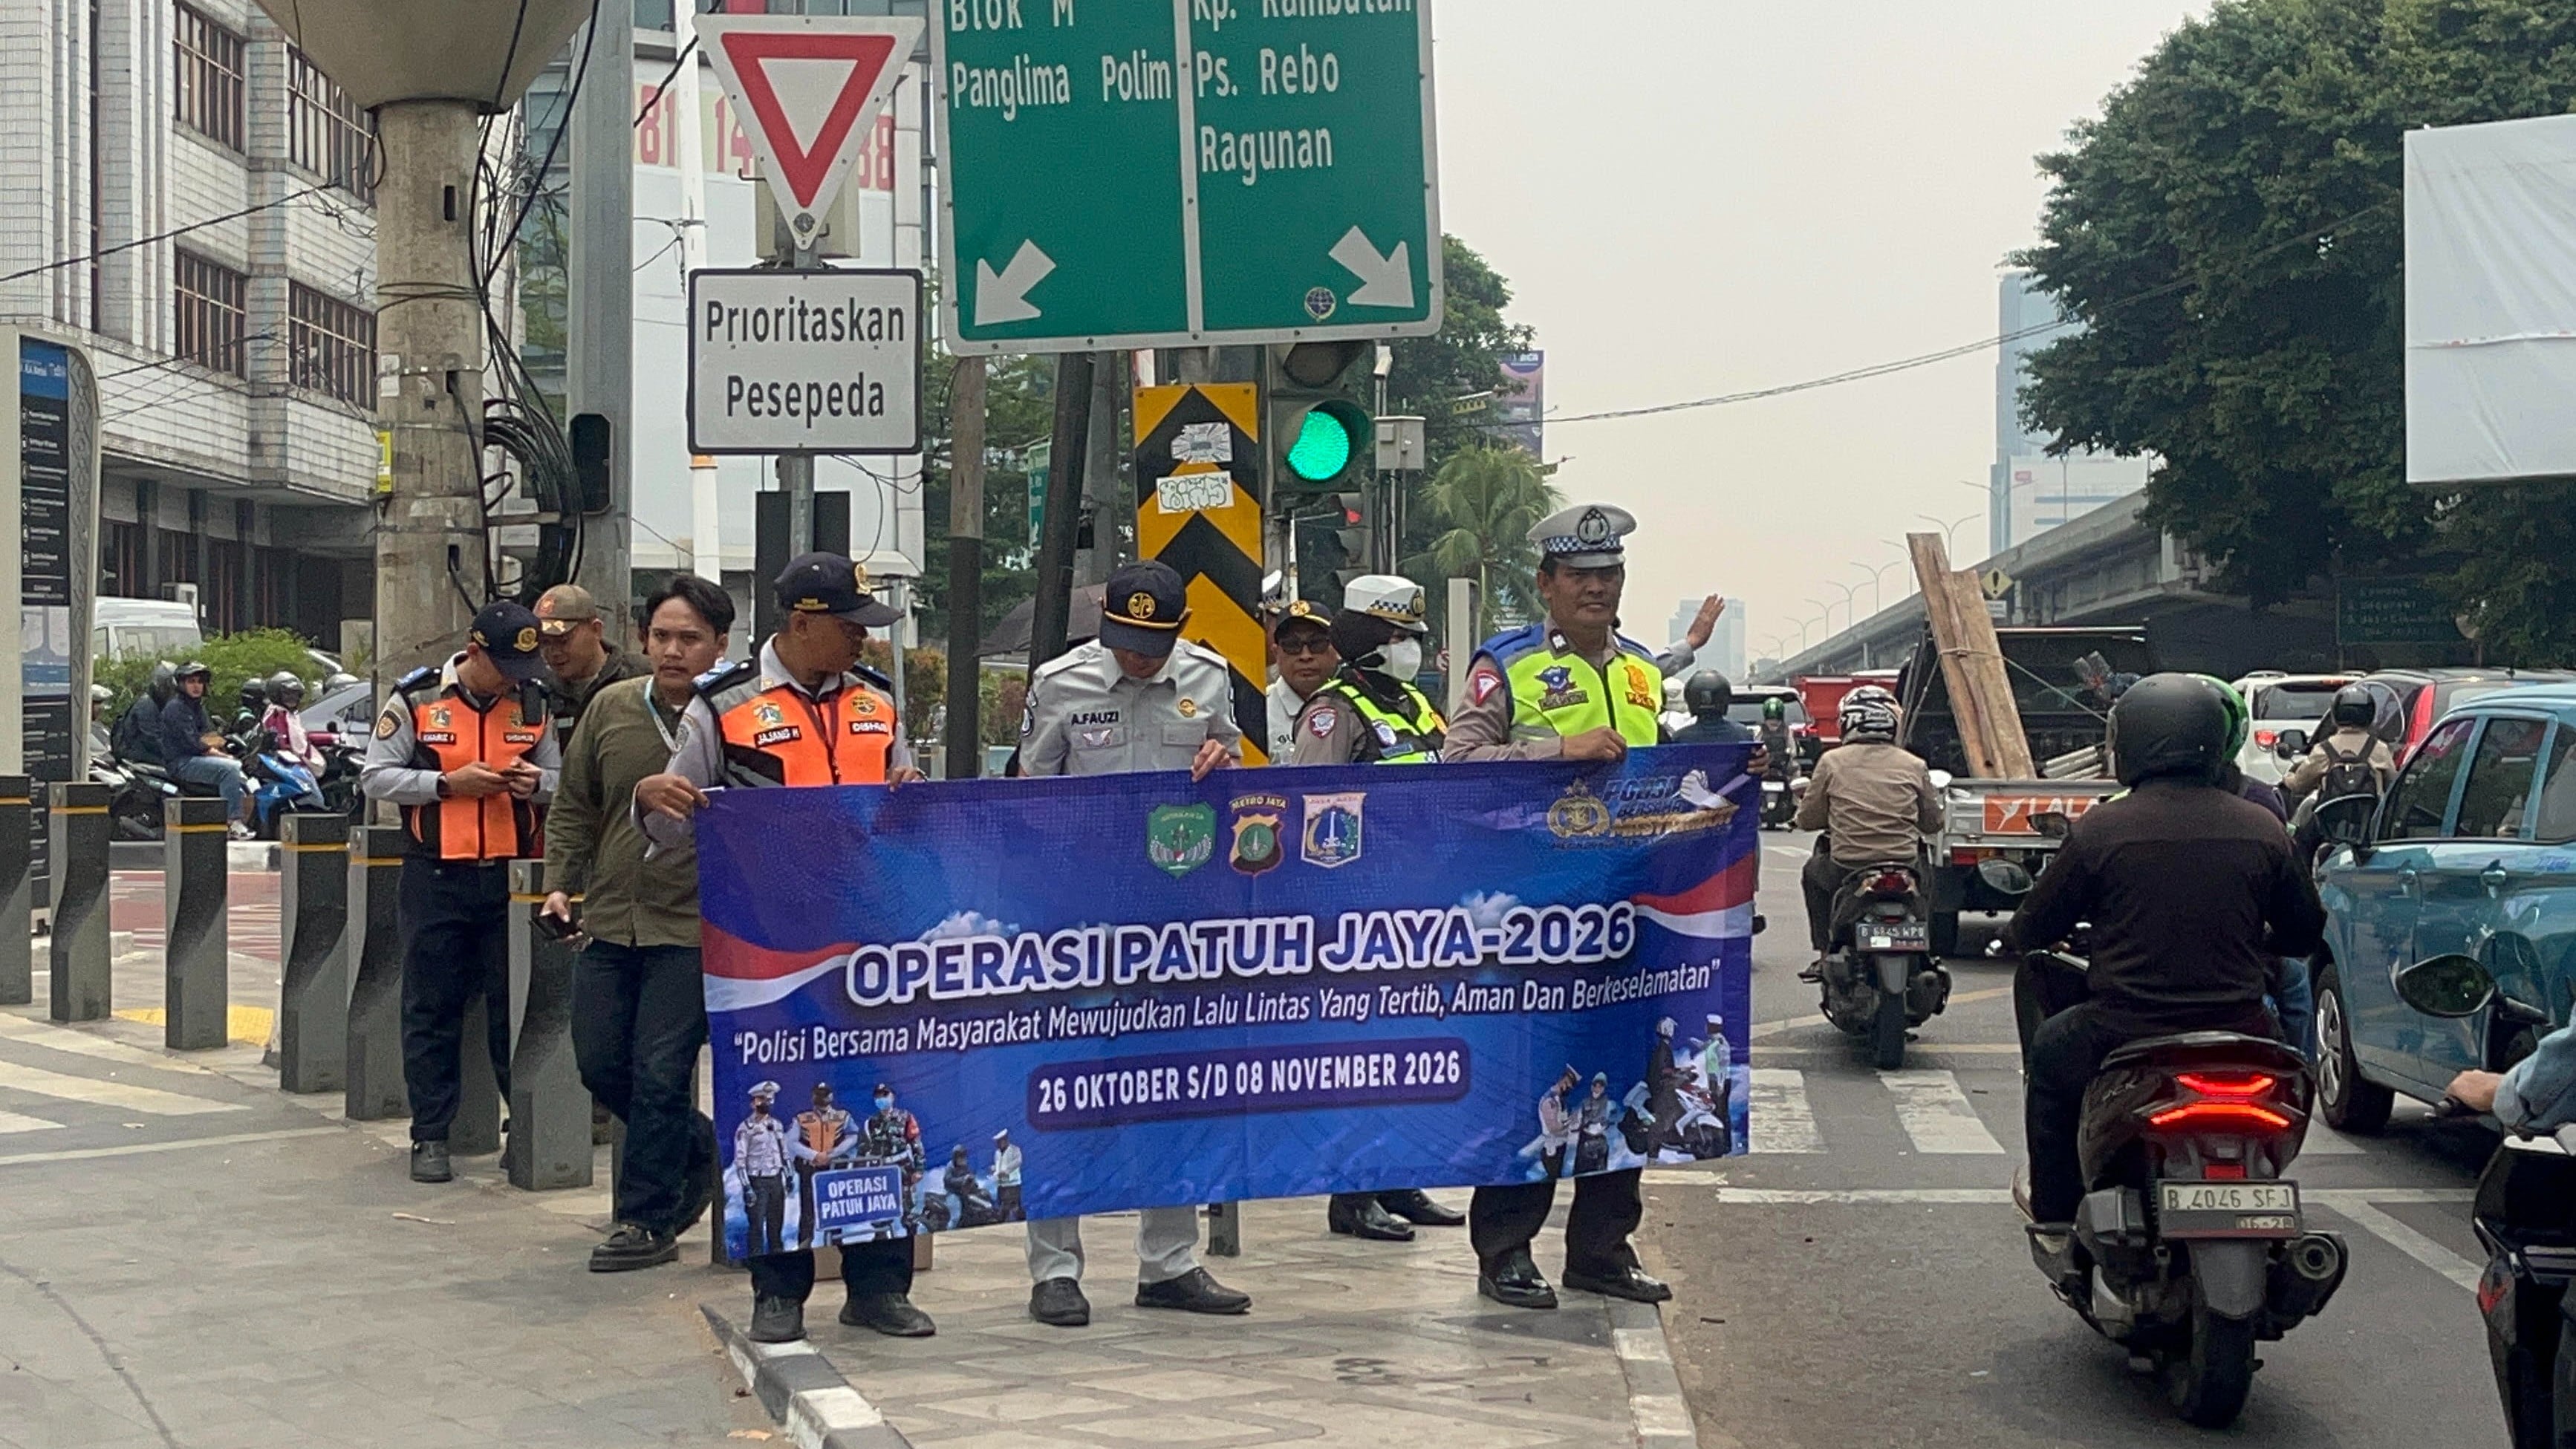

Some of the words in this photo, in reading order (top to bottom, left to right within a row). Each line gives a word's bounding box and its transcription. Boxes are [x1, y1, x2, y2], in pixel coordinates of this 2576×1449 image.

[951, 0, 1023, 31] Blok
[1053, 0, 1073, 27] M
[952, 53, 1070, 122] Panglima
[1102, 48, 1171, 102] Polim
[1197, 50, 1238, 98] Ps.
[1260, 42, 1339, 95] Rebo
[1200, 125, 1333, 186] Ragunan
[707, 296, 904, 342] Prioritaskan
[727, 371, 884, 429] Pesepeda
[1071, 711, 1119, 726] A.FAUZI
[1231, 796, 1263, 811] METRO
[1266, 795, 1287, 809] JAYA
[847, 928, 1105, 1006] OPERASI
[1113, 915, 1314, 986] PATUH
[1318, 901, 1634, 972] JAYA-2026
[735, 1029, 806, 1064] “Polisi
[813, 1025, 908, 1060] Bersama
[917, 1009, 1041, 1056] Masyarakat
[1048, 998, 1185, 1038] Mewujudkan
[1193, 993, 1238, 1026] Lalu
[1246, 991, 1310, 1023] Lintas
[1320, 987, 1370, 1021] Yang
[1379, 983, 1444, 1017] Tertib,
[1452, 981, 1515, 1012] Aman
[1523, 979, 1564, 1011] Dan
[1572, 958, 1720, 1010] Berkeselamatan”
[1038, 1077, 1066, 1113] 26
[1074, 1067, 1180, 1110] OKTOBER
[1188, 1062, 1227, 1100] S/D
[1235, 1061, 1263, 1095] 08
[1271, 1052, 1396, 1093] NOVEMBER
[1404, 1049, 1460, 1086] 2026
[822, 1196, 864, 1219] PATUH
[867, 1193, 897, 1213] JAYA
[827, 1175, 888, 1198] OPERASI
[2167, 1189, 2179, 1209] B
[2191, 1189, 2241, 1208] 4046
